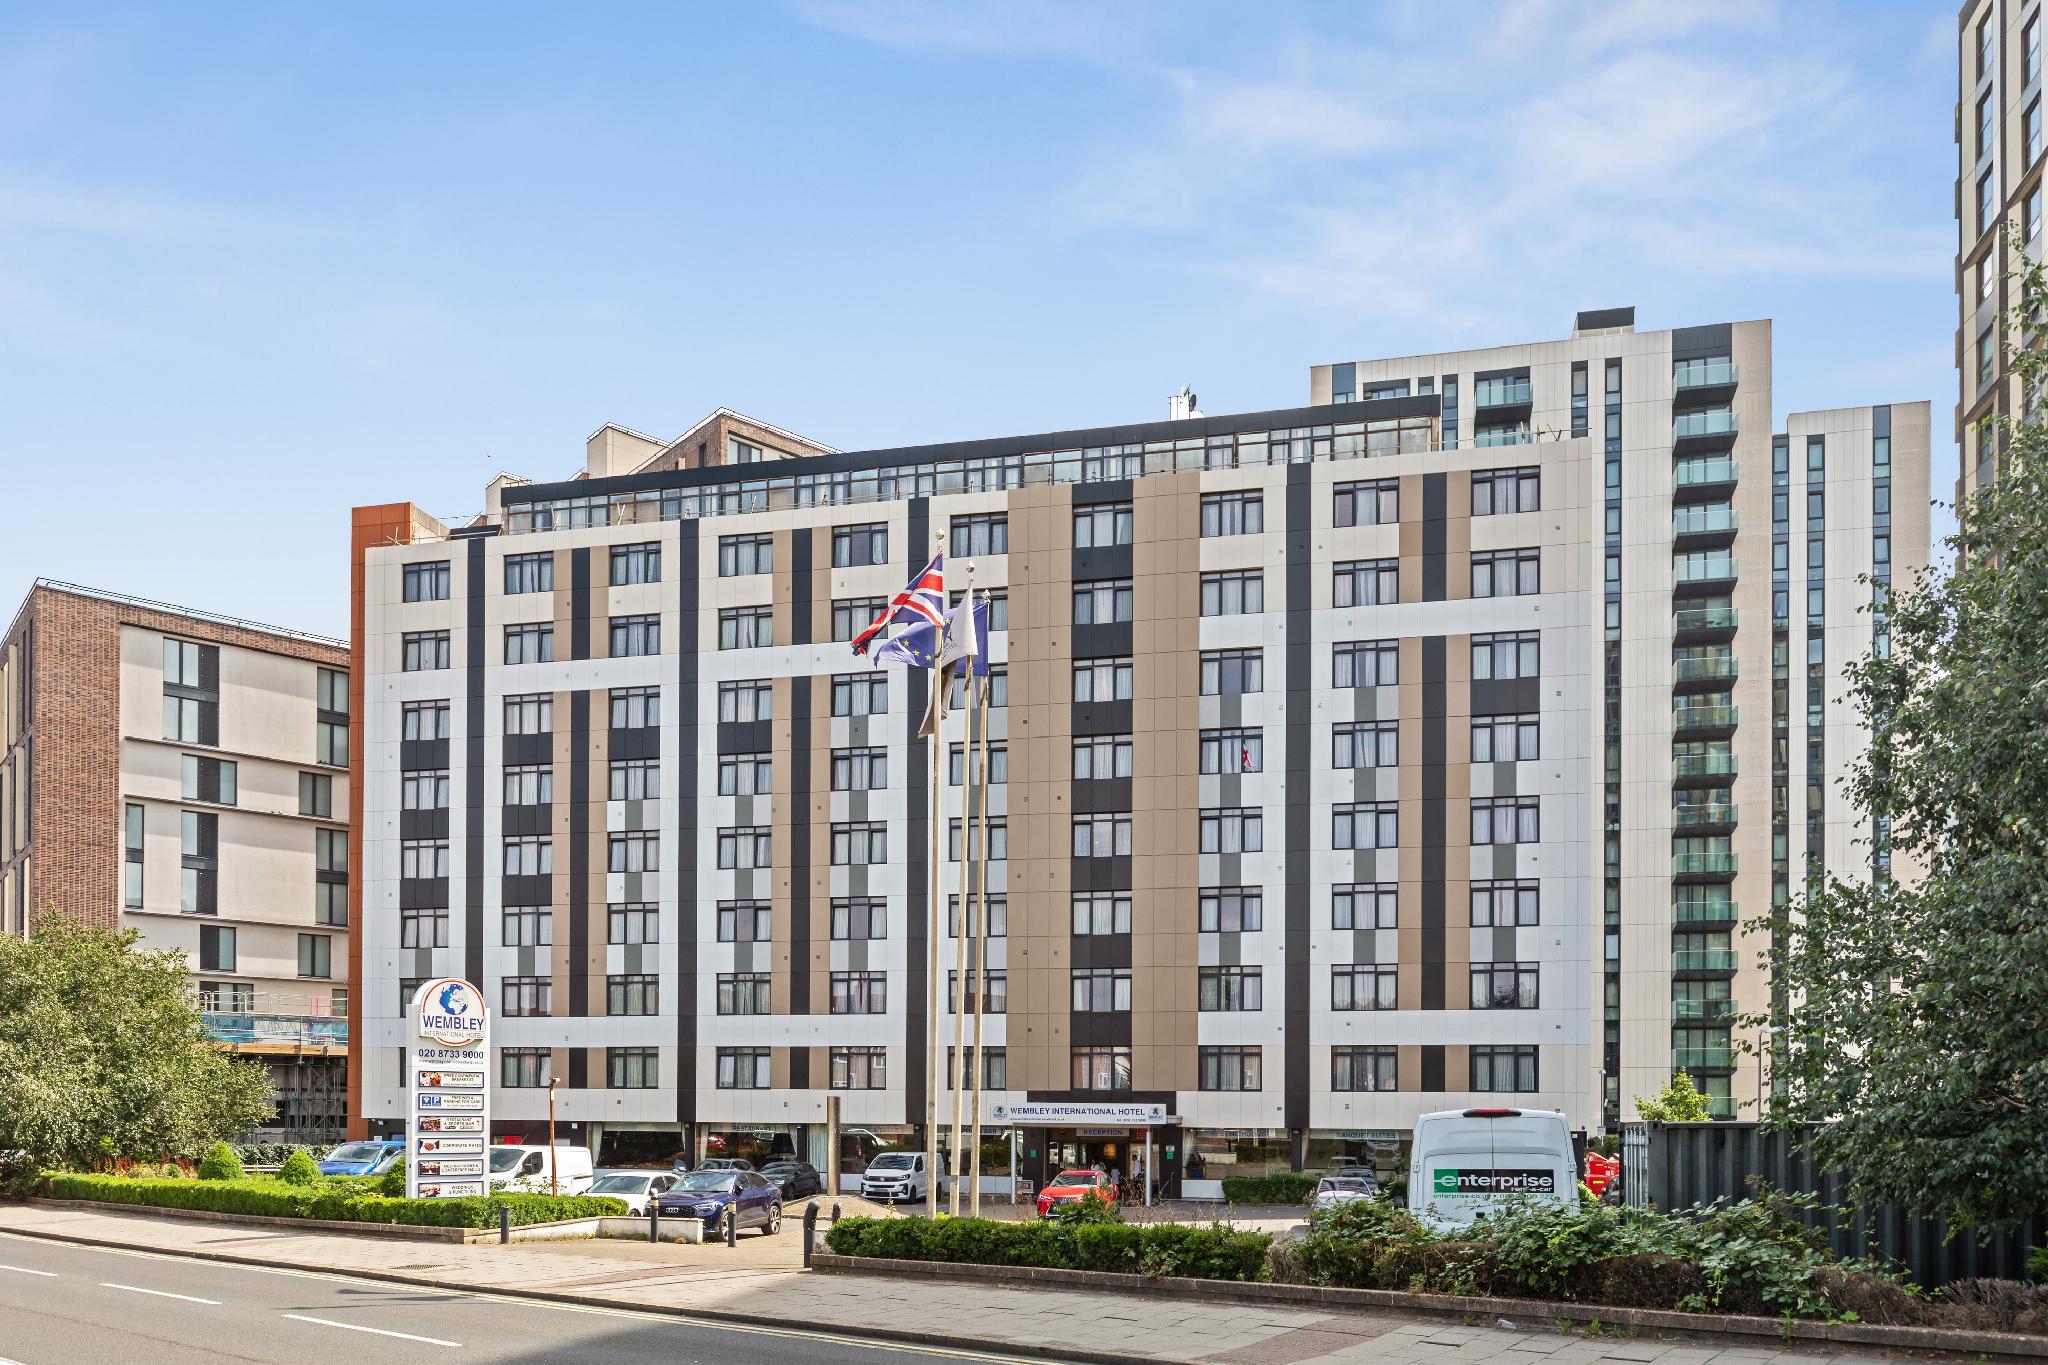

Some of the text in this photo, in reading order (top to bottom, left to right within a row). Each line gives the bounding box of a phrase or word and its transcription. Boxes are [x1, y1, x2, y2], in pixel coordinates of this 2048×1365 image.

[423, 1015, 484, 1030] WEMBLEY
[418, 1049, 484, 1058] 020 8733 9000
[1010, 1107, 1145, 1116] WEMBLEY INTERNATIONAL HOTEL
[1083, 1128, 1123, 1136] RECEPTION
[1438, 1174, 1553, 1189] enterprise
